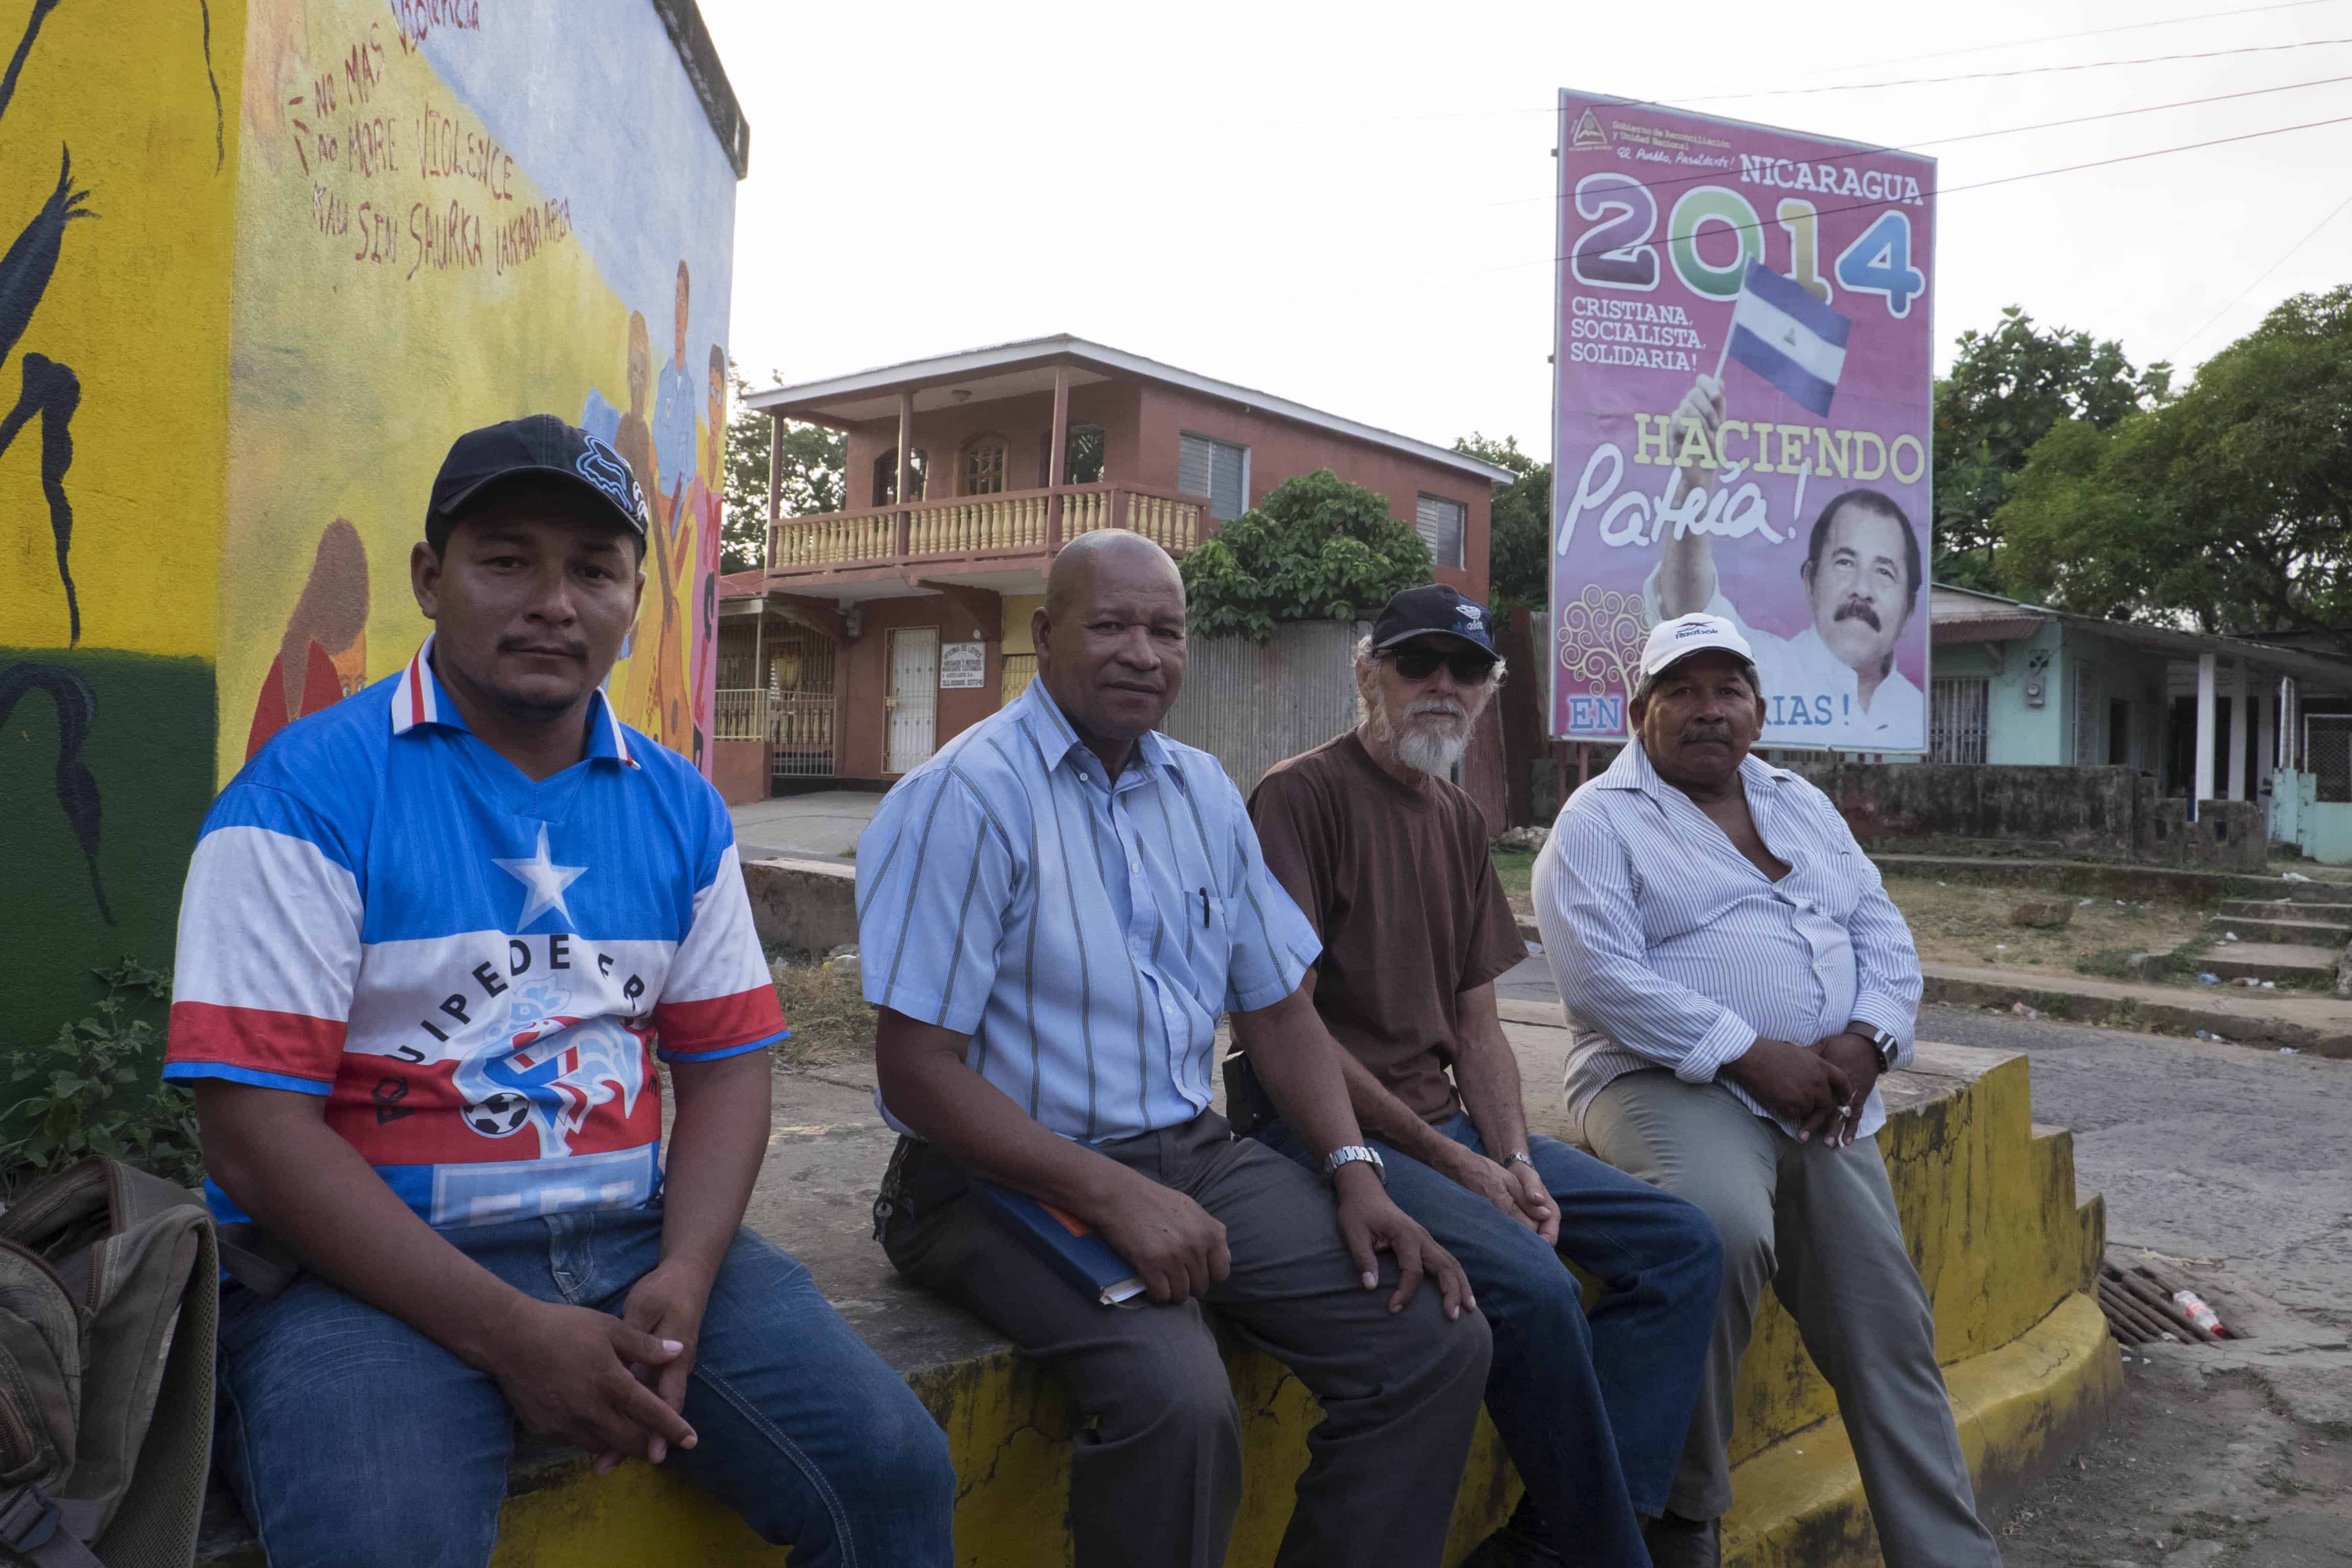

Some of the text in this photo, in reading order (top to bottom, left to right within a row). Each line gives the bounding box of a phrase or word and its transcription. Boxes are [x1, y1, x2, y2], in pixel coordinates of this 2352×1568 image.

[315, 73, 336, 119] NO
[345, 22, 385, 105] MAS
[1620, 131, 1650, 145] Unidad
[1652, 138, 1689, 150] Nacional
[1653, 128, 1663, 137] de
[348, 118, 399, 178] MORE
[416, 102, 513, 201] VIOLENCE
[1739, 153, 1924, 206] NICARAGUA
[355, 201, 398, 263] SIN
[406, 198, 483, 281] SAURKA
[1571, 172, 1926, 319] 2014
[1571, 296, 1694, 326] CRISTIANA,
[1570, 319, 1707, 350] SOCIALISTA,
[1570, 342, 1698, 371] SOLIDARIA!
[1633, 413, 1925, 485] HACIENDO
[1675, 628, 1719, 639] Reebok
[1569, 697, 1621, 730] EN
